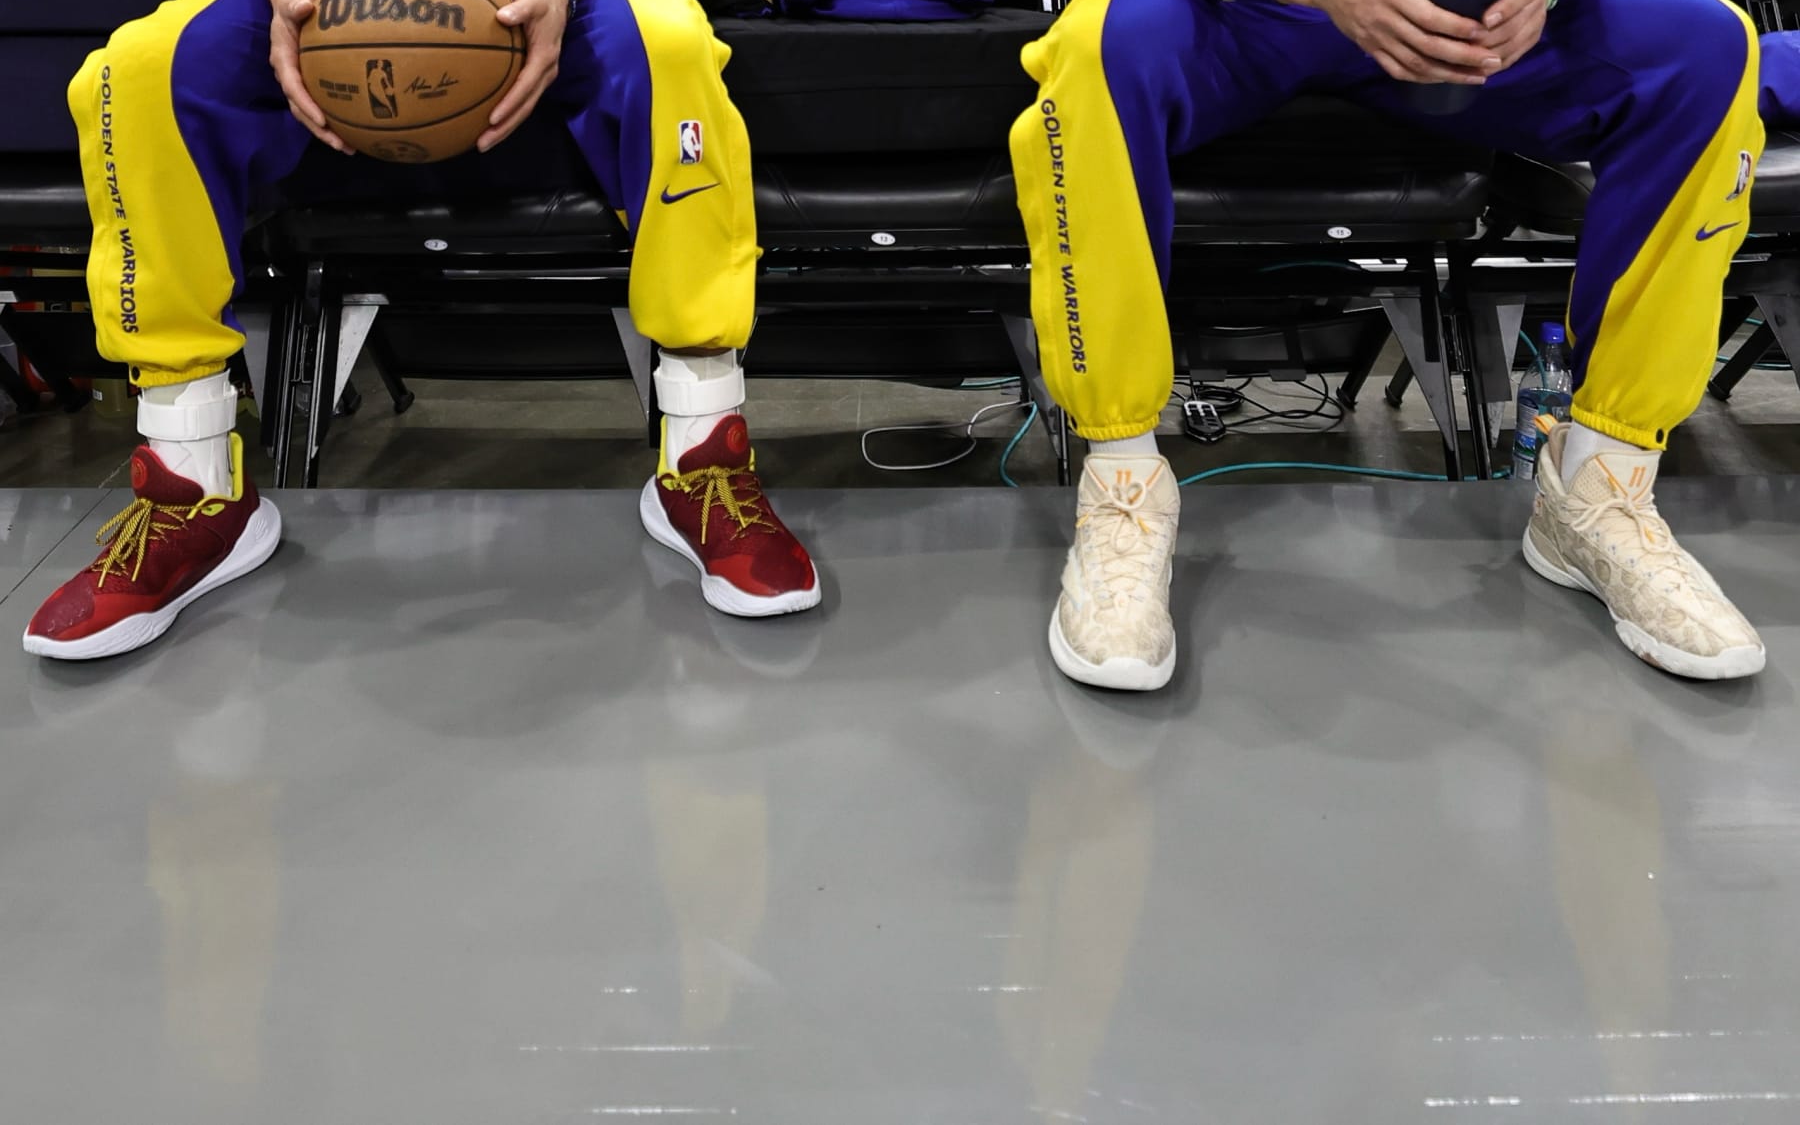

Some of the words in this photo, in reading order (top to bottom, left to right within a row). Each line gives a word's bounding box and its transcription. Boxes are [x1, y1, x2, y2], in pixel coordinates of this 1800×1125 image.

[101, 65, 114, 156] GOLDEN
[1041, 98, 1065, 188] GOLDEN
[105, 161, 126, 220] STATE
[1054, 193, 1071, 256] STATE
[119, 228, 139, 334] WARRIORS
[1060, 264, 1087, 374] WARRIORS
